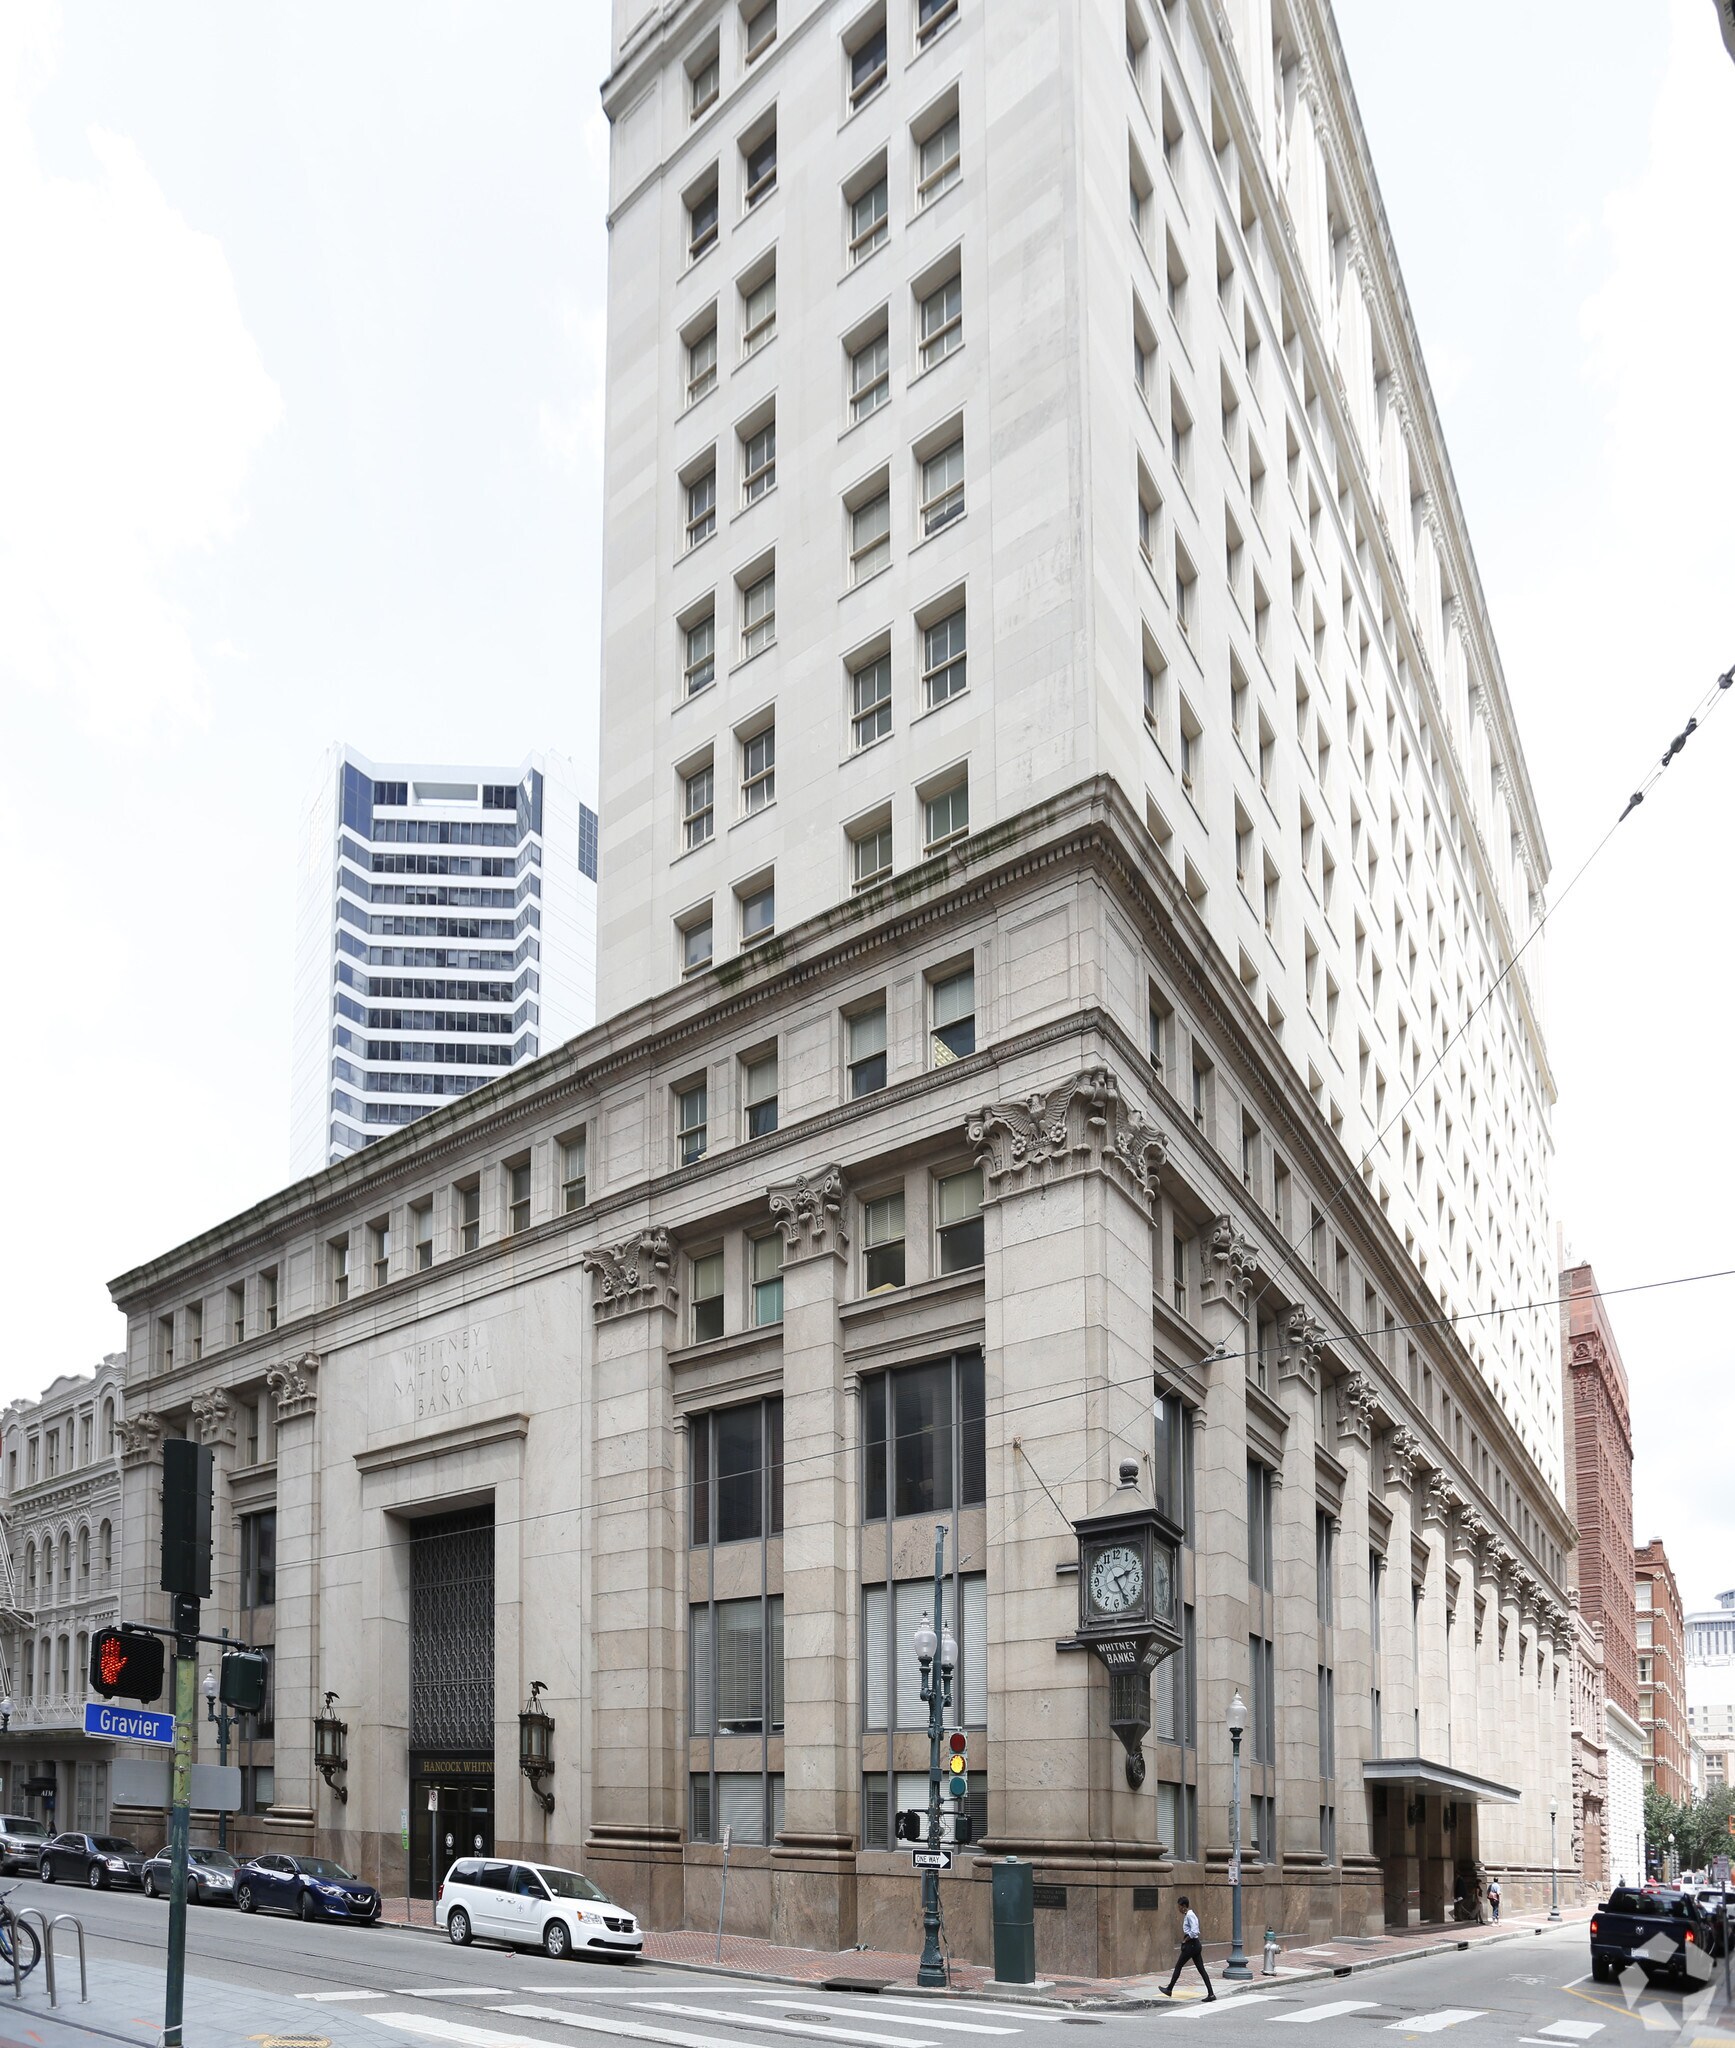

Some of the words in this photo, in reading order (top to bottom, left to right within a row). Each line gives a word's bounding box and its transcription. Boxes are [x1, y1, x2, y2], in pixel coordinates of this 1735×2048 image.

[404, 1327, 480, 1367] WHITNEY
[394, 1352, 492, 1397] NATIONAL
[418, 1387, 464, 1416] BANK
[1104, 1554, 1110, 1564] 11
[1113, 1550, 1120, 1560] 12
[1125, 1552, 1129, 1562] 1
[1094, 1564, 1104, 1574] 10
[1132, 1560, 1137, 1570] 2
[1094, 1577, 1100, 1587] 9
[1134, 1572, 1140, 1582] 3
[1096, 1589, 1102, 1599] 8
[1130, 1585, 1136, 1595] 4
[1105, 1597, 1109, 1607] 7
[1114, 1599, 1119, 1609] 6
[1096, 1641, 1137, 1652] WHITNEY
[1106, 1652, 1136, 1664] BANKS
[100, 1709, 159, 1737] Gravier
[423, 1762, 461, 1772] HANCOCK
[463, 1762, 495, 1772] WHITN
[917, 1855, 927, 1863] ONE
